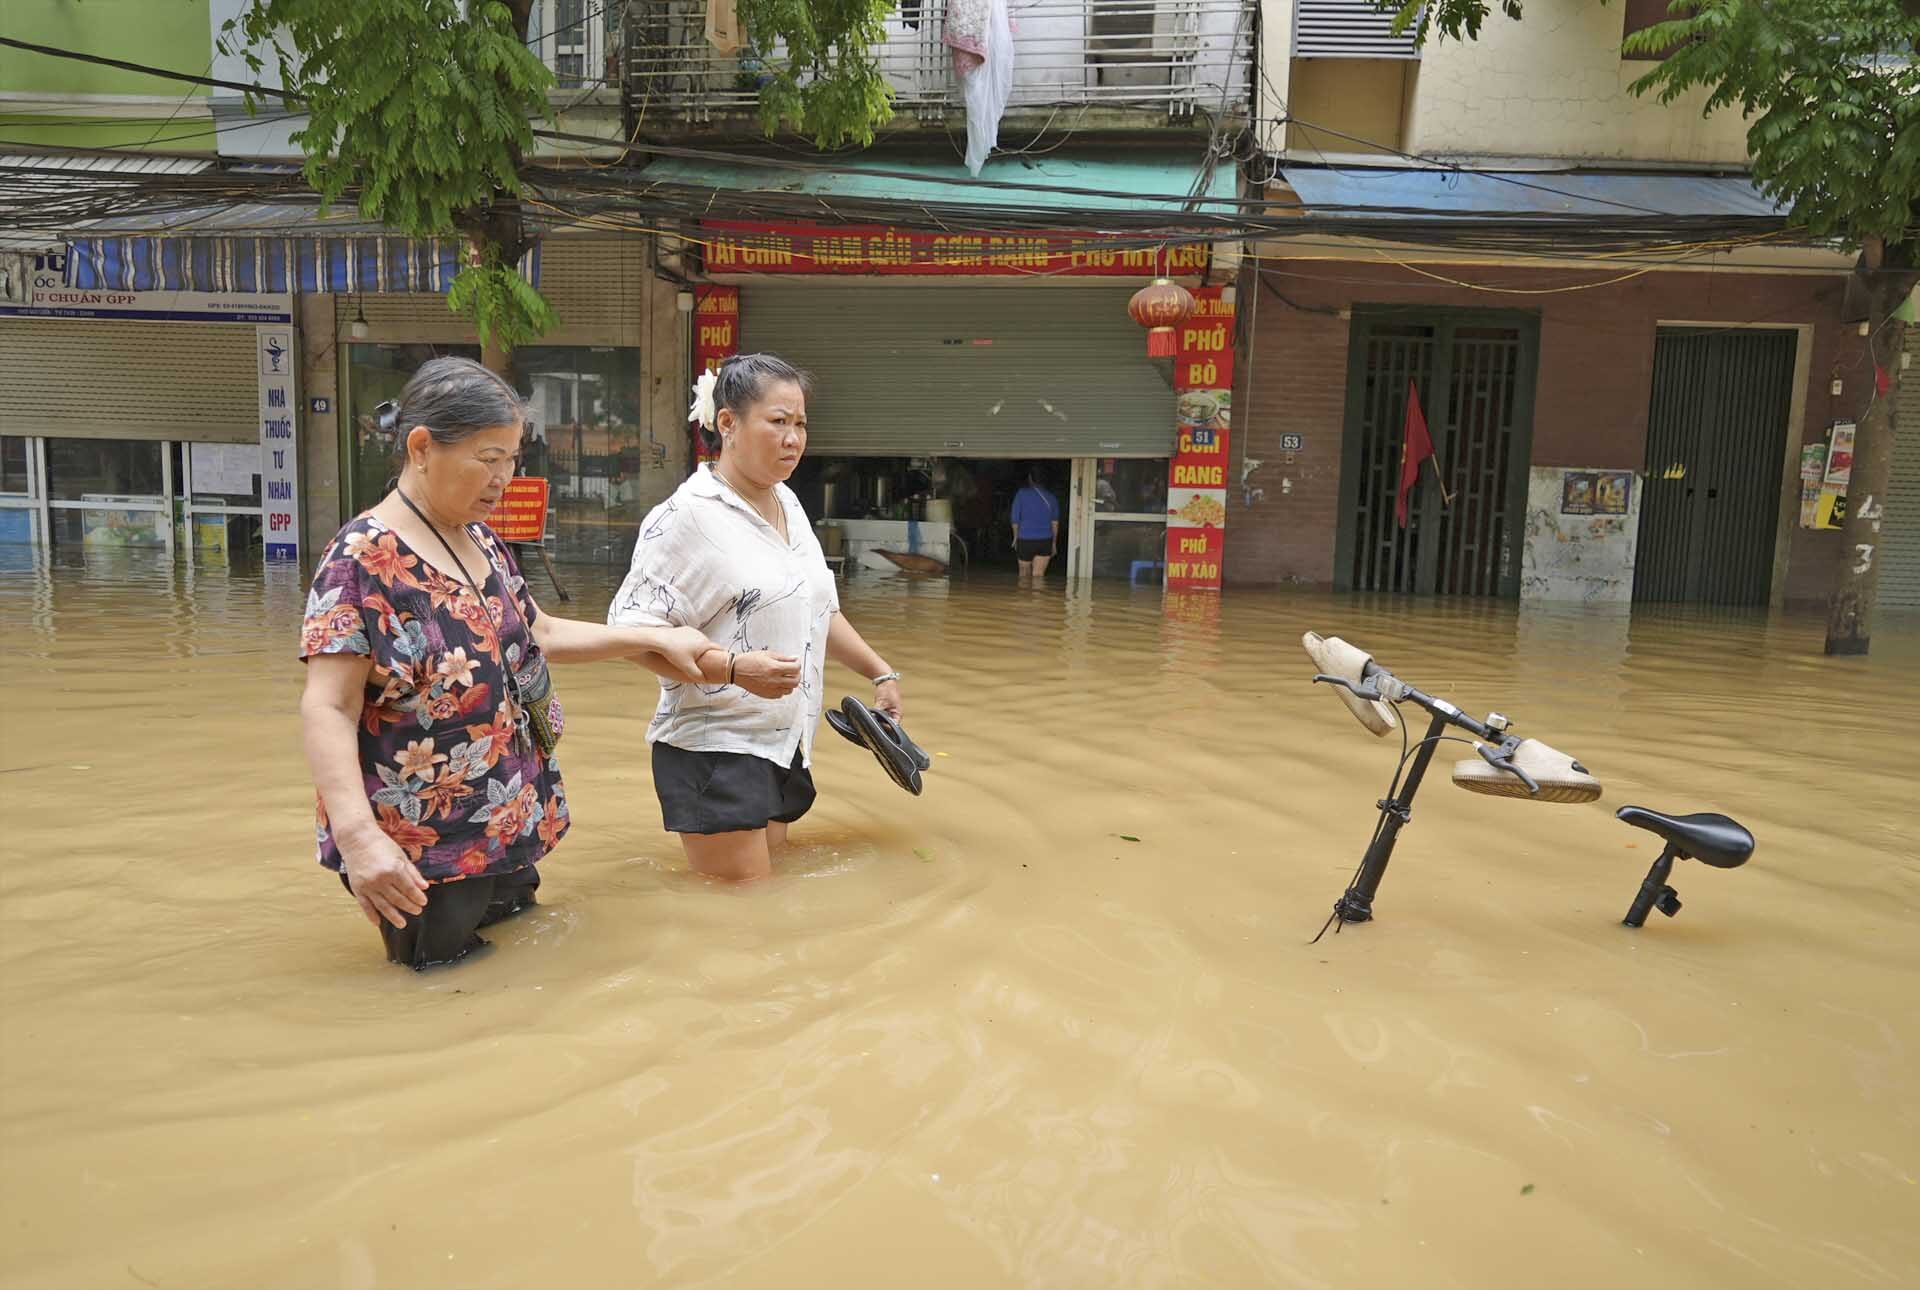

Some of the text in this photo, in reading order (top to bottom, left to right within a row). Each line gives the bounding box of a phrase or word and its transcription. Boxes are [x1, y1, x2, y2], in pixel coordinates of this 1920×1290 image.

[106, 295, 137, 305] GPP
[701, 320, 732, 347] PHỞ
[1183, 322, 1227, 351] PHỞ
[1189, 358, 1217, 385] BÒ
[268, 388, 286, 408] NHÀ
[314, 399, 327, 411] 49
[265, 414, 291, 439] THUỐC
[1195, 431, 1209, 443] 51
[1284, 436, 1299, 448] 53
[273, 450, 284, 469] TƯ
[1174, 465, 1223, 484] RANG
[268, 479, 291, 500] NHÂN
[270, 513, 291, 531] GPP
[1857, 495, 1883, 532] 4
[1180, 534, 1208, 554] PHỞ
[1853, 543, 1875, 574] 3
[1191, 560, 1217, 578] XÀO
